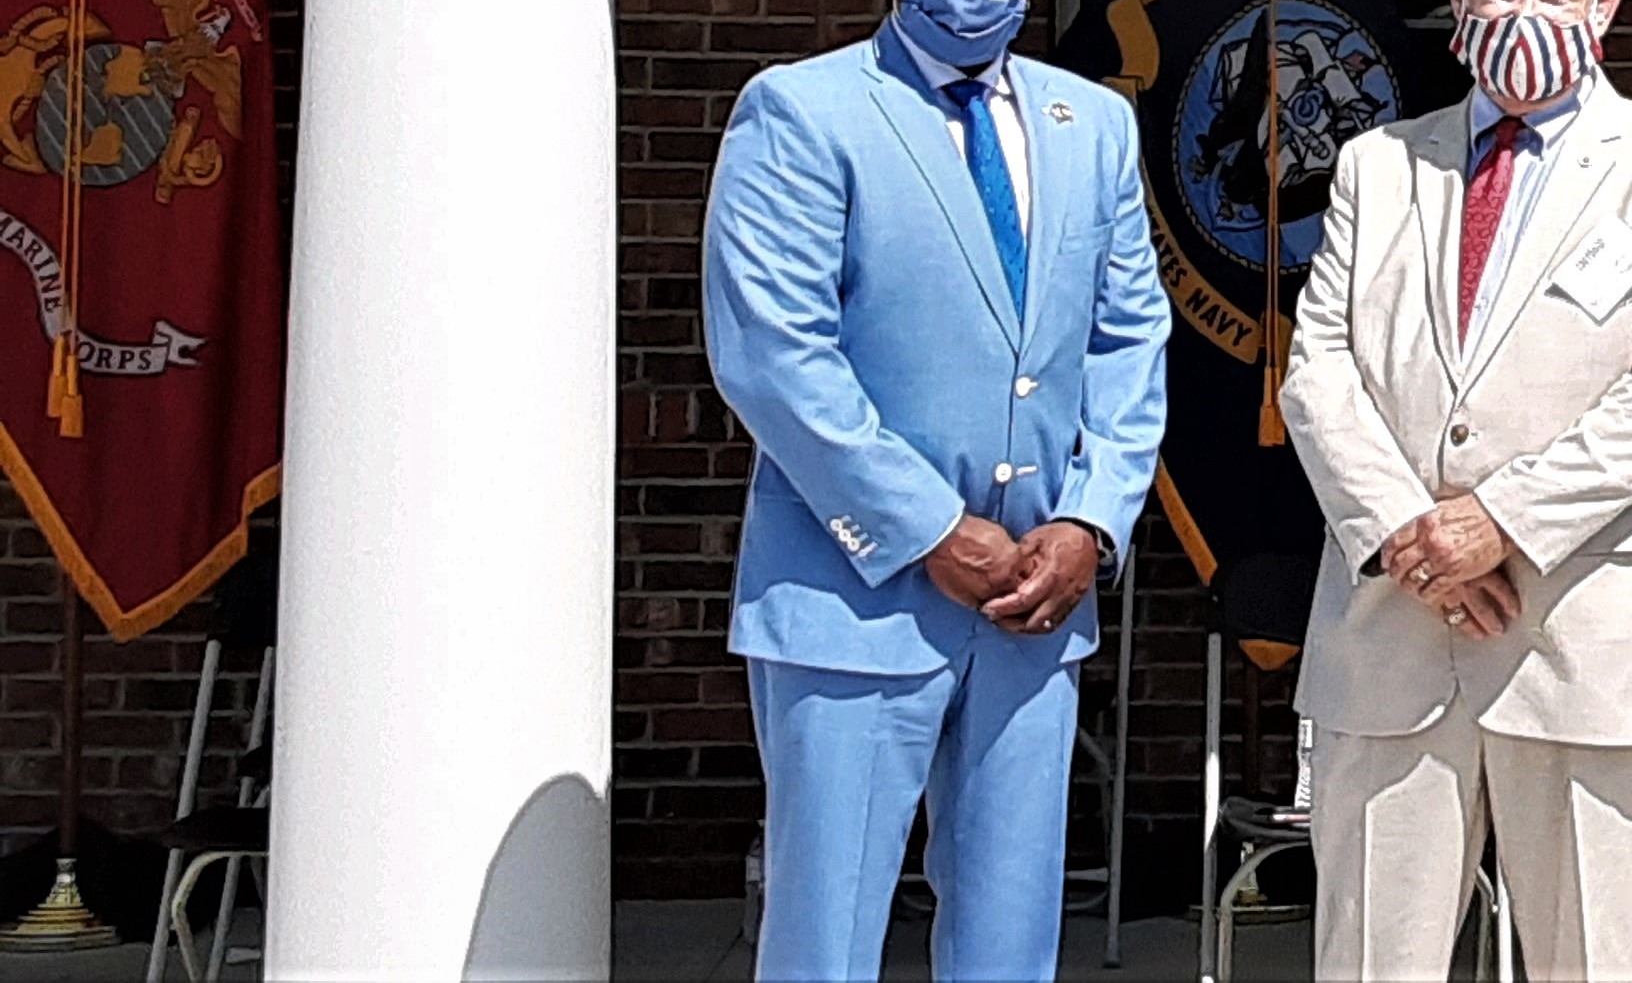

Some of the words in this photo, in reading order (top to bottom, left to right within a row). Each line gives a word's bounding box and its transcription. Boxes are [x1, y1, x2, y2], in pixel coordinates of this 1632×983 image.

[1151, 220, 1188, 288] ATES
[1185, 287, 1253, 348] NAVY
[64, 331, 153, 371] ORPS
